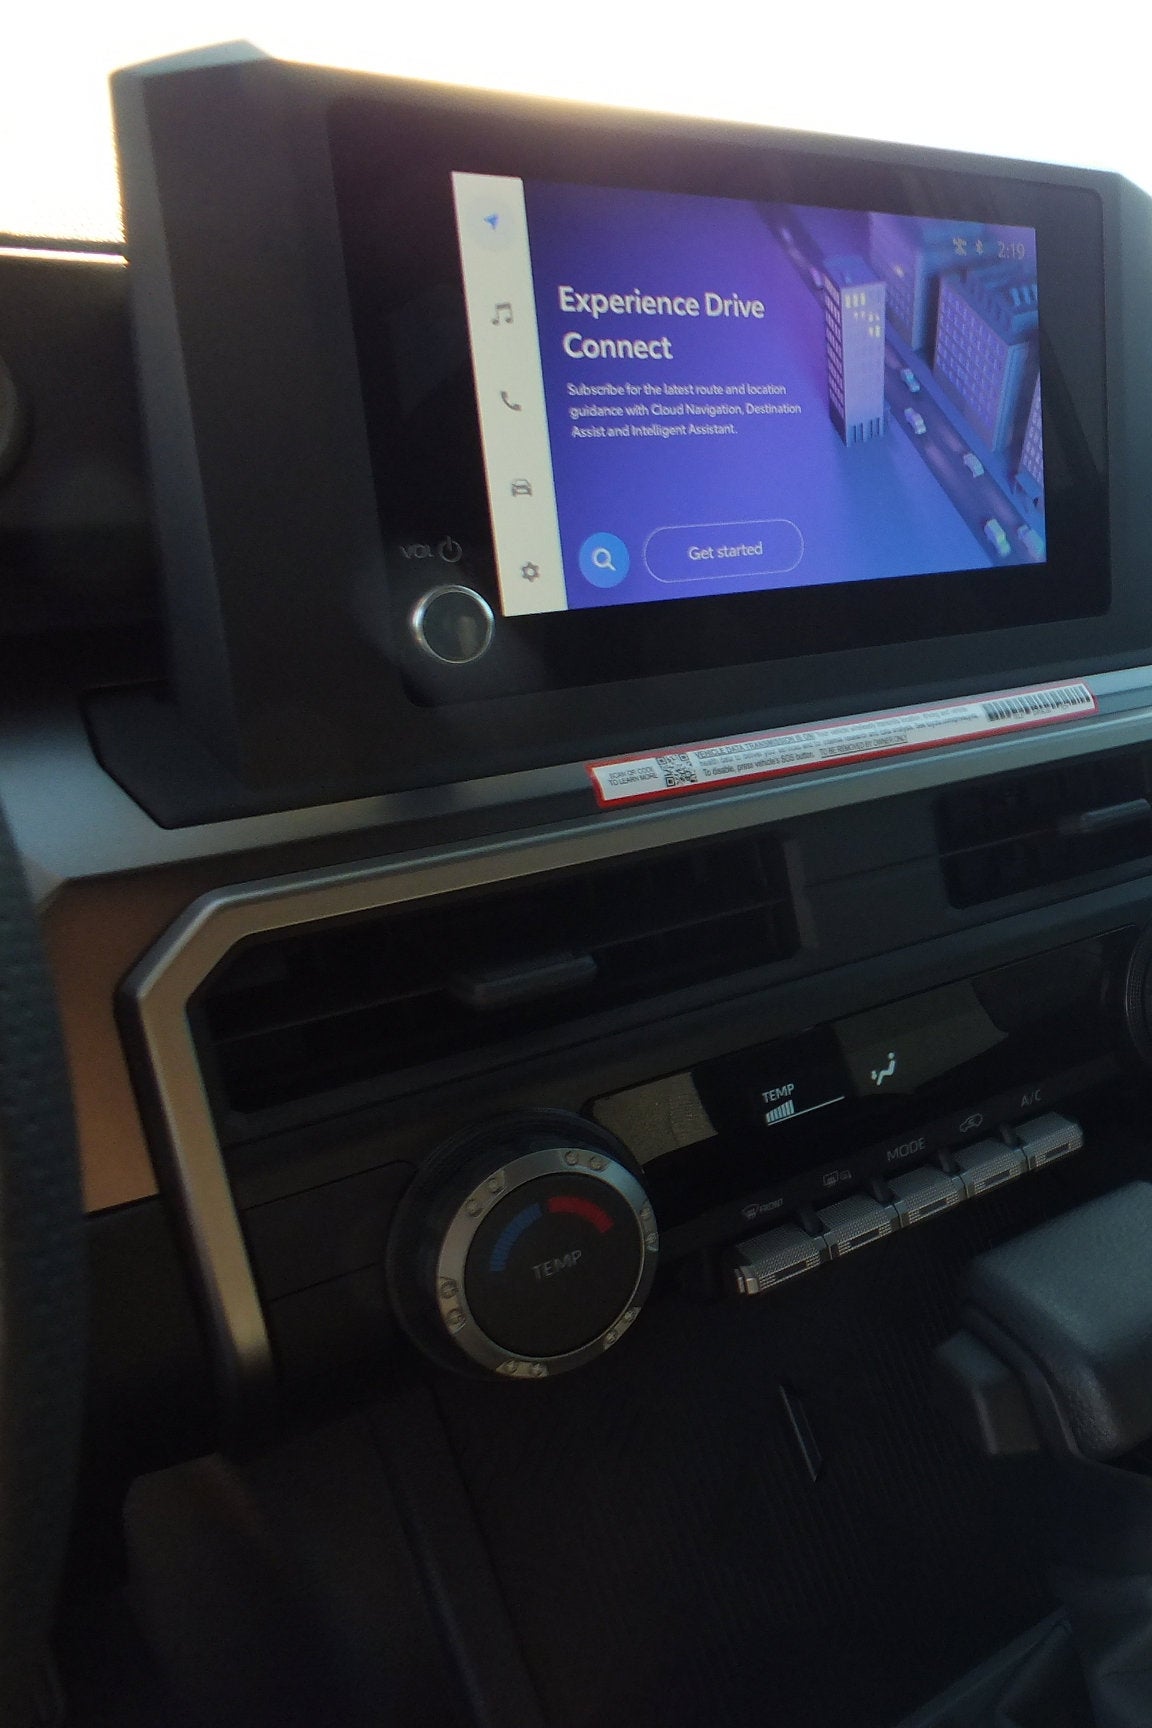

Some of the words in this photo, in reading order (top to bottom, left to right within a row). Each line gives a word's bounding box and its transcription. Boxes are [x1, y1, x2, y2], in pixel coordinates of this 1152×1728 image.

[999, 241, 1025, 259] 2:19
[558, 285, 700, 319] Experience
[705, 291, 766, 319] Drive
[563, 331, 673, 360] Connect
[567, 382, 625, 396] Subscribe
[626, 382, 641, 396] for
[643, 382, 662, 395] the
[663, 382, 695, 396] latest
[696, 384, 724, 395] route
[725, 383, 745, 395] and
[747, 383, 787, 395] location
[569, 404, 624, 420] guidance
[625, 403, 649, 416] with
[650, 403, 684, 416] Cloud
[685, 403, 744, 418] Navigation,
[745, 402, 801, 415] Destination
[571, 425, 606, 438] Assist
[607, 424, 630, 437] and
[631, 423, 687, 439] Intelligent
[688, 423, 738, 435] Assistant.
[400, 543, 435, 559] VOL
[688, 545, 714, 561] Get
[717, 541, 763, 560] started
[619, 775, 639, 784] LEARN
[703, 768, 711, 777] To
[761, 1083, 795, 1103] TEMP
[1021, 1089, 1041, 1107] A/C
[887, 1136, 926, 1161] MODE
[531, 1250, 582, 1280] TEMP
